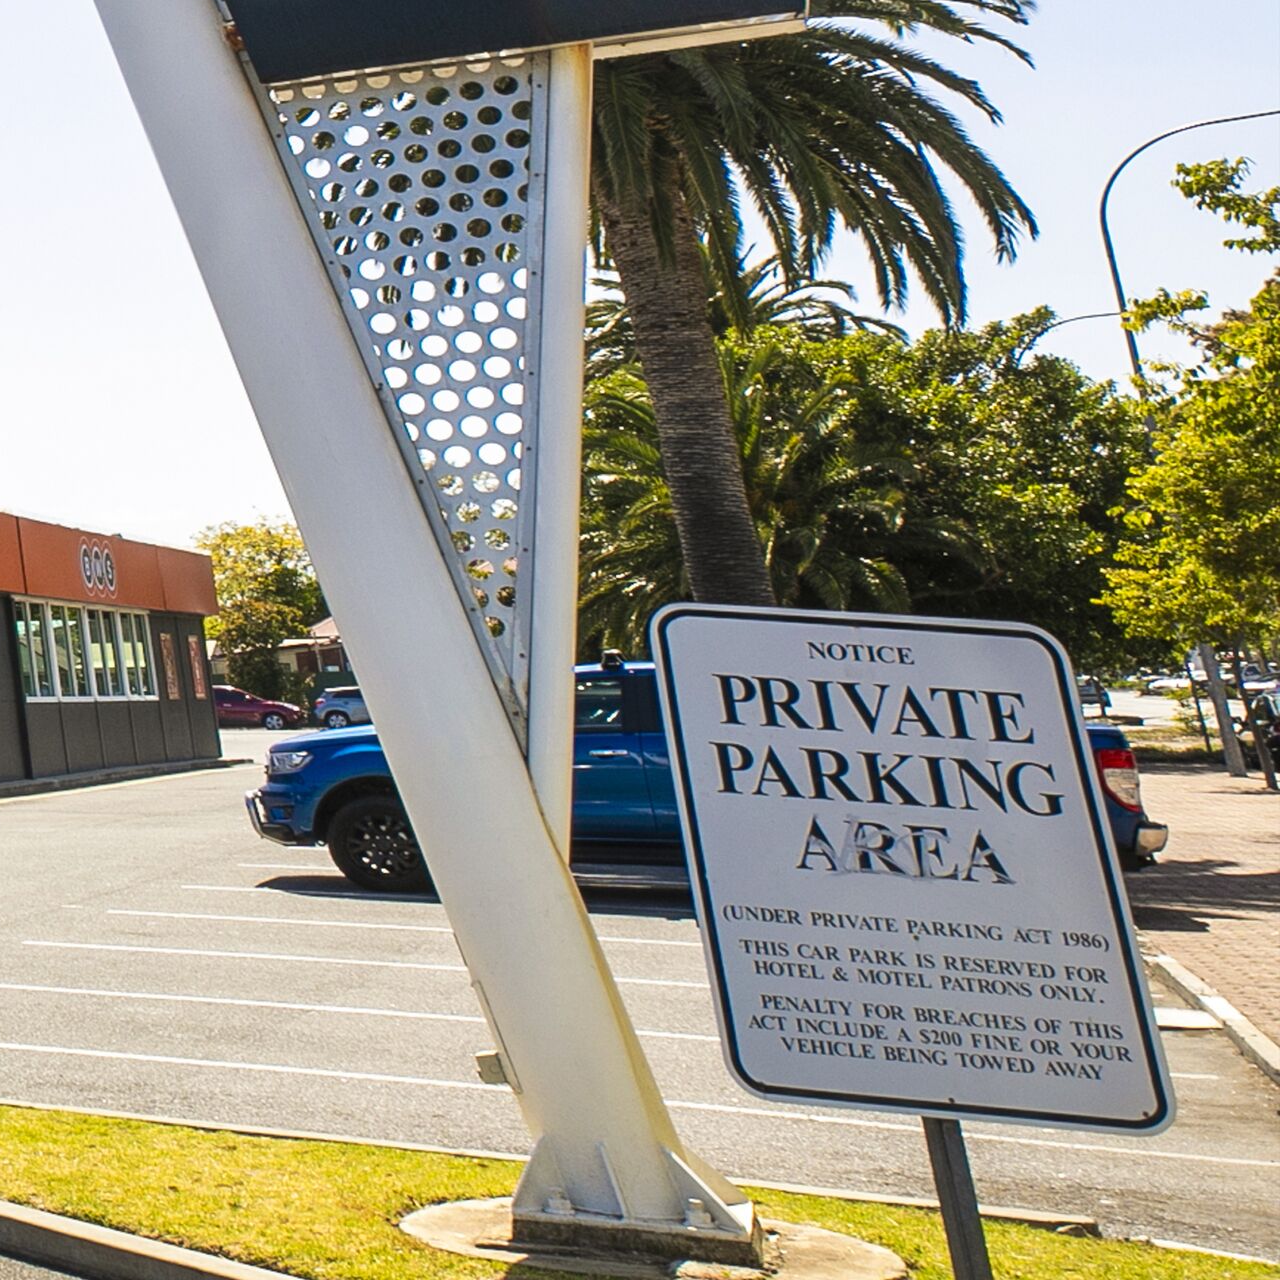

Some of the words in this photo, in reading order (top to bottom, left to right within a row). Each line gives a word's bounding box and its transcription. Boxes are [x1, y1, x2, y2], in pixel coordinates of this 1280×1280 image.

[805, 640, 916, 666] NOTICE
[711, 672, 1035, 745] PRIVATE
[708, 740, 1065, 817] PARKING
[795, 814, 1017, 885] AREA
[721, 903, 803, 926] (UNDER
[810, 910, 899, 934] PRIVATE
[906, 918, 1003, 942] PARKING
[1013, 927, 1053, 946] ACT
[1062, 930, 1111, 953] 1986)
[739, 938, 790, 958] THIS
[797, 943, 841, 962] CAR
[848, 947, 907, 968] PARK
[915, 952, 936, 969] IS
[943, 955, 1056, 980] RESERVED
[1064, 964, 1110, 985] FOR
[753, 959, 825, 981] HOTEL
[832, 966, 850, 982] &
[857, 968, 933, 990] MOTEL
[939, 975, 1033, 999] PATRONS
[1039, 984, 1106, 1005] ONLY.
[747, 1013, 787, 1032] ACT
[795, 1016, 889, 1041] INCLUDE
[896, 1026, 913, 1043] A
[919, 1028, 963, 1047] $200
[971, 1032, 1024, 1053] FINE
[1029, 1037, 1064, 1057] OR
[1069, 1040, 1133, 1063] YOUR
[759, 993, 854, 1018] PENALTY
[862, 1001, 906, 1021] FOR
[914, 1007, 1027, 1033] BREACHES
[1034, 1018, 1064, 1035] OF
[1069, 1020, 1124, 1041] THIS
[779, 1036, 877, 1061] VEHICLE
[883, 1044, 949, 1068] BEING
[955, 1050, 1036, 1075] TOWED
[1044, 1059, 1104, 1081] AWAY
